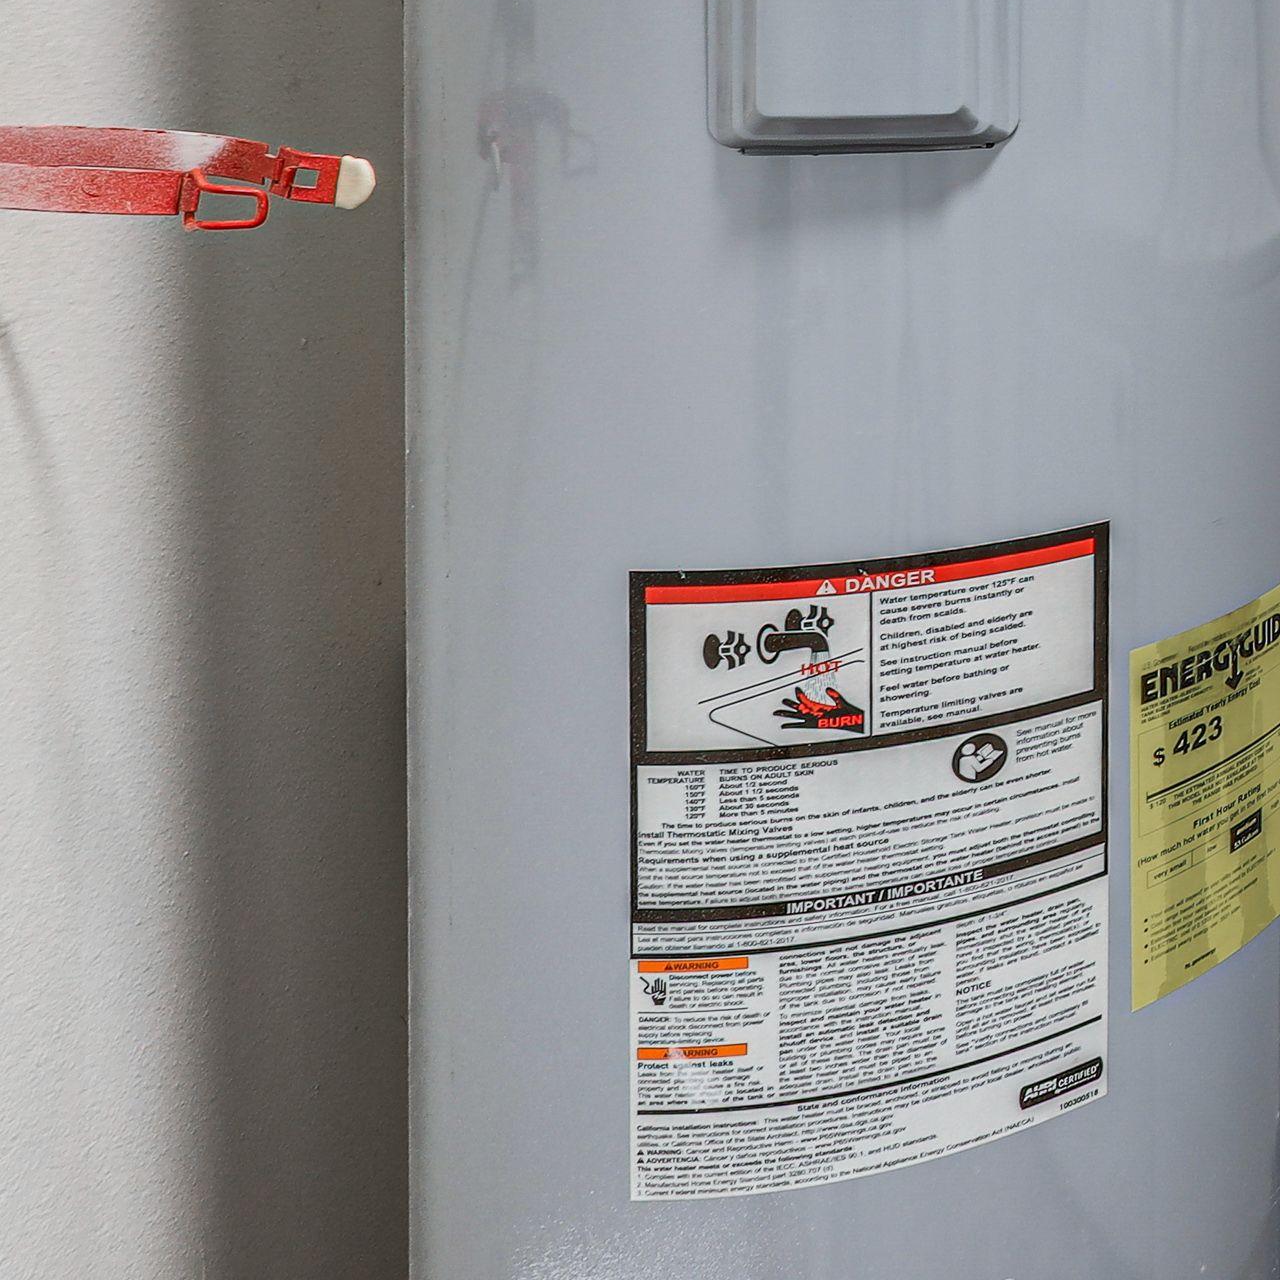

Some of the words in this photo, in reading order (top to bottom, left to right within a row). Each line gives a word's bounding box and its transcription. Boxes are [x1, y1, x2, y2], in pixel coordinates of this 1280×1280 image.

[845, 571, 936, 594] DANGER
[880, 596, 907, 605] Water
[910, 588, 966, 601] temperature
[969, 584, 989, 593] over
[1019, 575, 1034, 583] can
[880, 606, 908, 615] cause
[911, 602, 941, 610] severe
[945, 596, 971, 607] burns
[974, 589, 1012, 602] instantly
[880, 616, 906, 625] death
[909, 611, 931, 621] from
[926, 621, 965, 635] disabled
[968, 618, 985, 627] and
[987, 613, 1017, 626] elderly
[892, 638, 927, 650] highest
[930, 635, 947, 644] risk
[950, 632, 959, 641] of
[962, 629, 986, 640] being
[989, 621, 1026, 634] scalded.
[880, 659, 897, 667] See
[901, 650, 951, 664] instruction
[954, 644, 987, 655] manual
[990, 638, 1018, 649] before
[880, 667, 912, 677] setting
[915, 657, 971, 673] temperature
[985, 650, 1009, 660] water
[1012, 643, 1041, 655] heater.
[801, 661, 841, 677] HOT
[880, 684, 900, 692] Feel
[903, 680, 928, 689] water
[931, 674, 960, 684] before
[963, 666, 997, 679] bathing
[1000, 664, 1010, 672] or
[880, 690, 932, 703] showering.
[881, 703, 939, 718] Temperature
[941, 696, 975, 709] limiting
[978, 690, 1007, 702] valves
[1009, 686, 1023, 694] are
[1169, 709, 1204, 729] Estimated
[1205, 697, 1226, 713] Yearly
[1227, 687, 1248, 703] Energy
[817, 715, 863, 728] BURN
[880, 716, 924, 729] available,
[927, 712, 943, 720] see
[946, 705, 983, 717] manual.
[1153, 747, 1165, 767] $
[1173, 715, 1222, 755] 423
[756, 764, 796, 772] PRODUCE
[801, 759, 838, 769] SERIOUS
[764, 771, 792, 779] ADULT
[795, 769, 814, 777] SKIN
[1193, 813, 1214, 829] First
[1217, 801, 1236, 816] Hour
[1238, 783, 1262, 805] Rating
[668, 829, 726, 838] Thermostatic
[729, 828, 759, 837] Mixing
[763, 825, 793, 834] Valves
[787, 891, 877, 915] IMPORTANT
[887, 869, 983, 899] IMPORTANTE
[673, 961, 720, 971] WARNING
[956, 979, 992, 996] NOTICE
